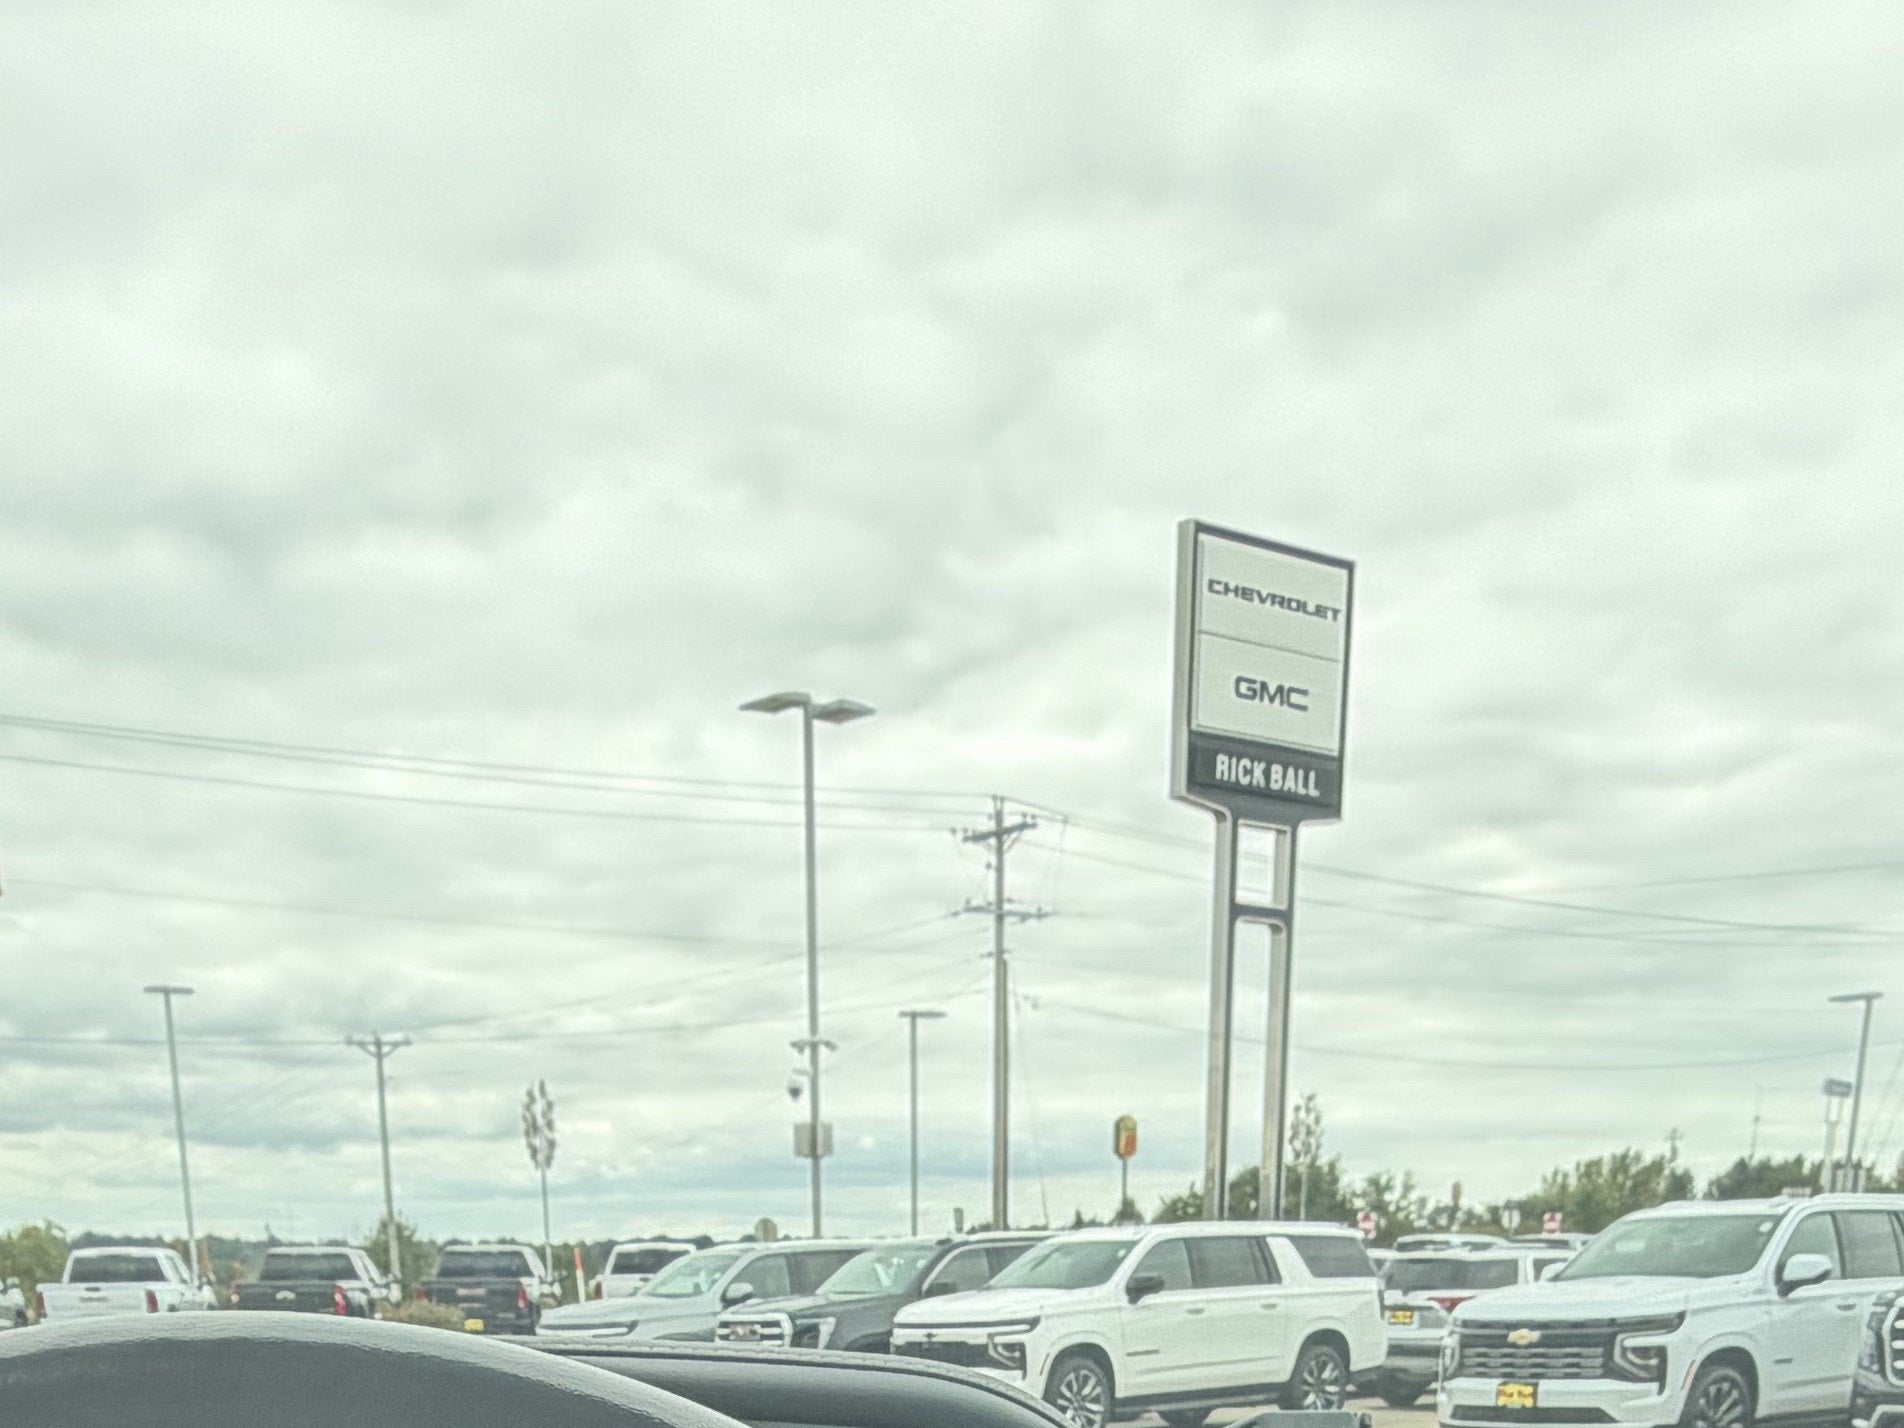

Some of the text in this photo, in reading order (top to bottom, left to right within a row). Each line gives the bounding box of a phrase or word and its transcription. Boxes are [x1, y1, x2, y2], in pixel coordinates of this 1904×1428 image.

[1207, 578, 1341, 623] CHEVROLET
[1233, 675, 1310, 712] GMC
[1215, 753, 1321, 797] RICK BALL
